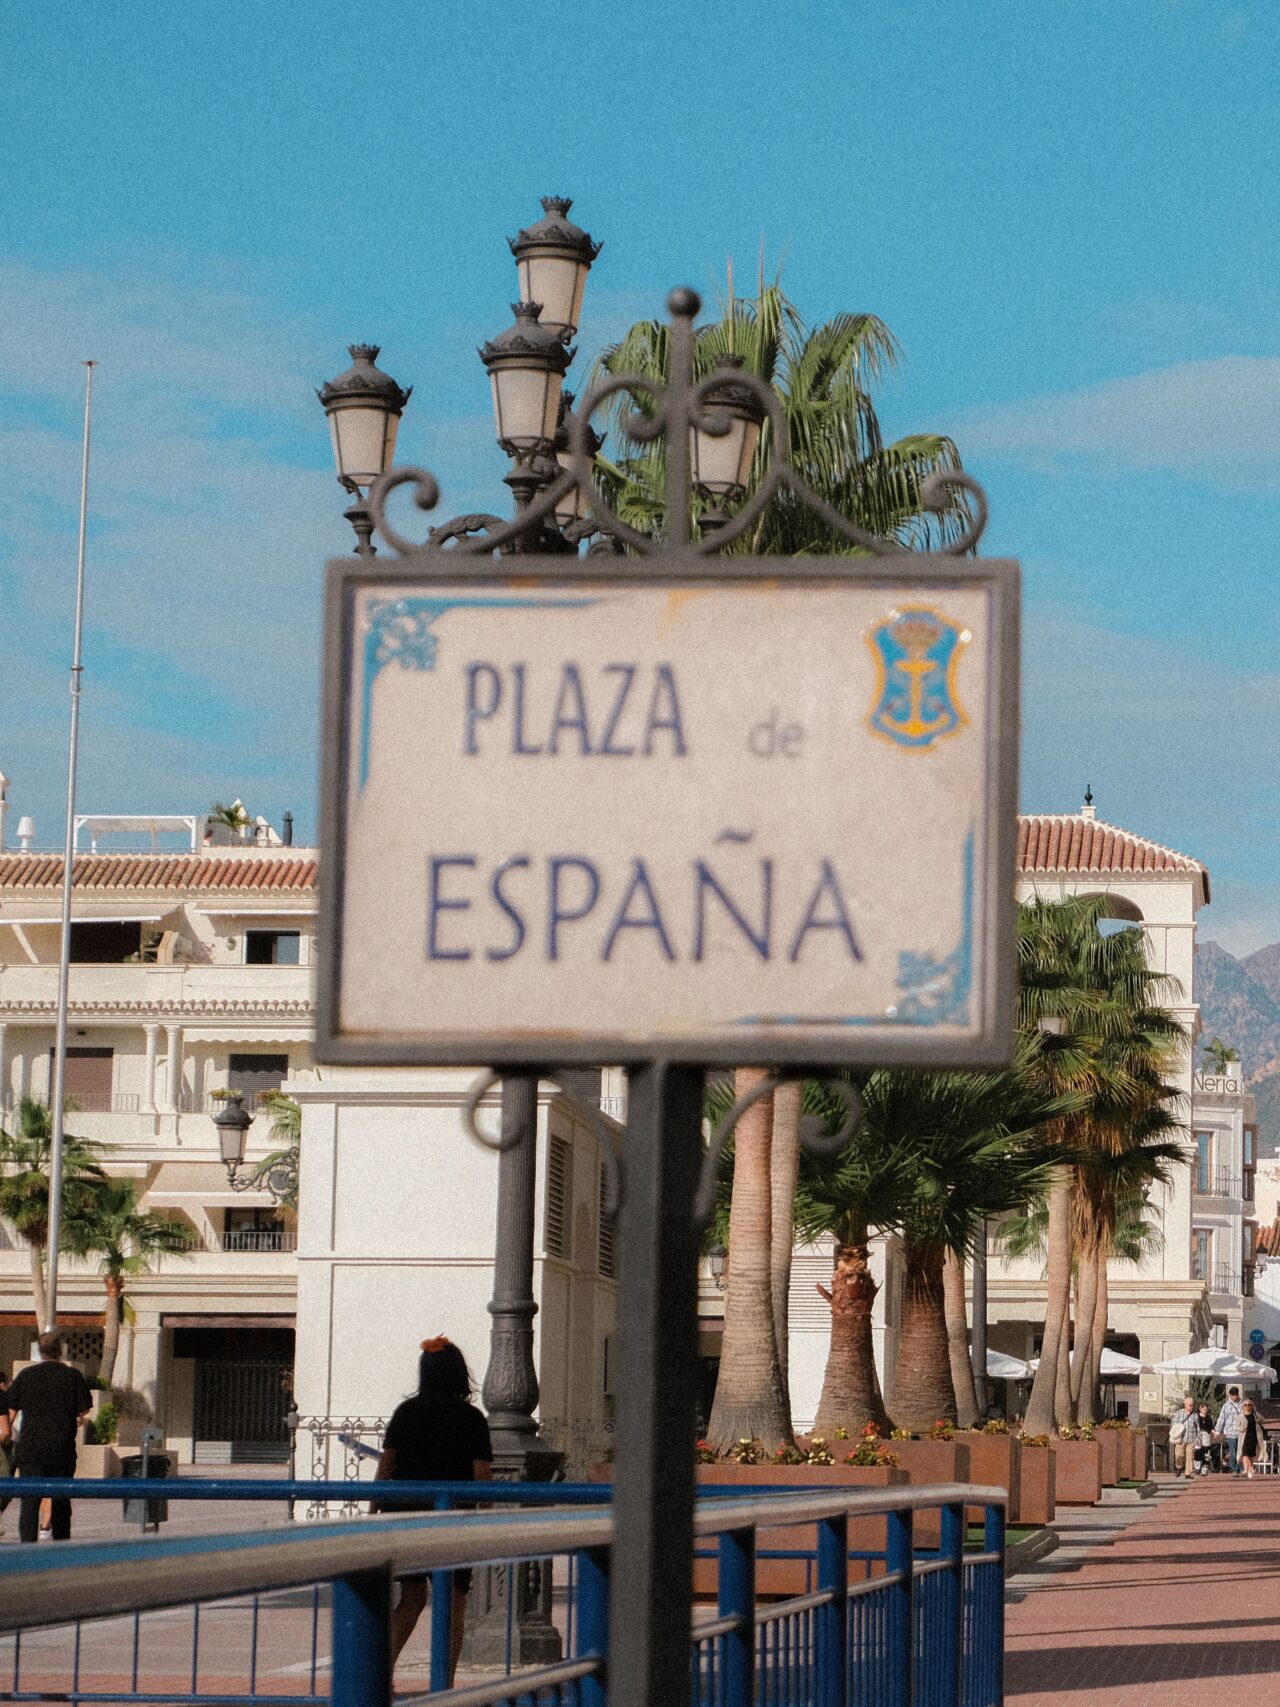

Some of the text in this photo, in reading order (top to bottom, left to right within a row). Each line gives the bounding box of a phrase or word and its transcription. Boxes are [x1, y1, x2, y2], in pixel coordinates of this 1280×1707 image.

[464, 660, 804, 759] PLAZA de
[426, 829, 864, 963] ESPAÑA
[1193, 1072, 1238, 1096] Nerja
